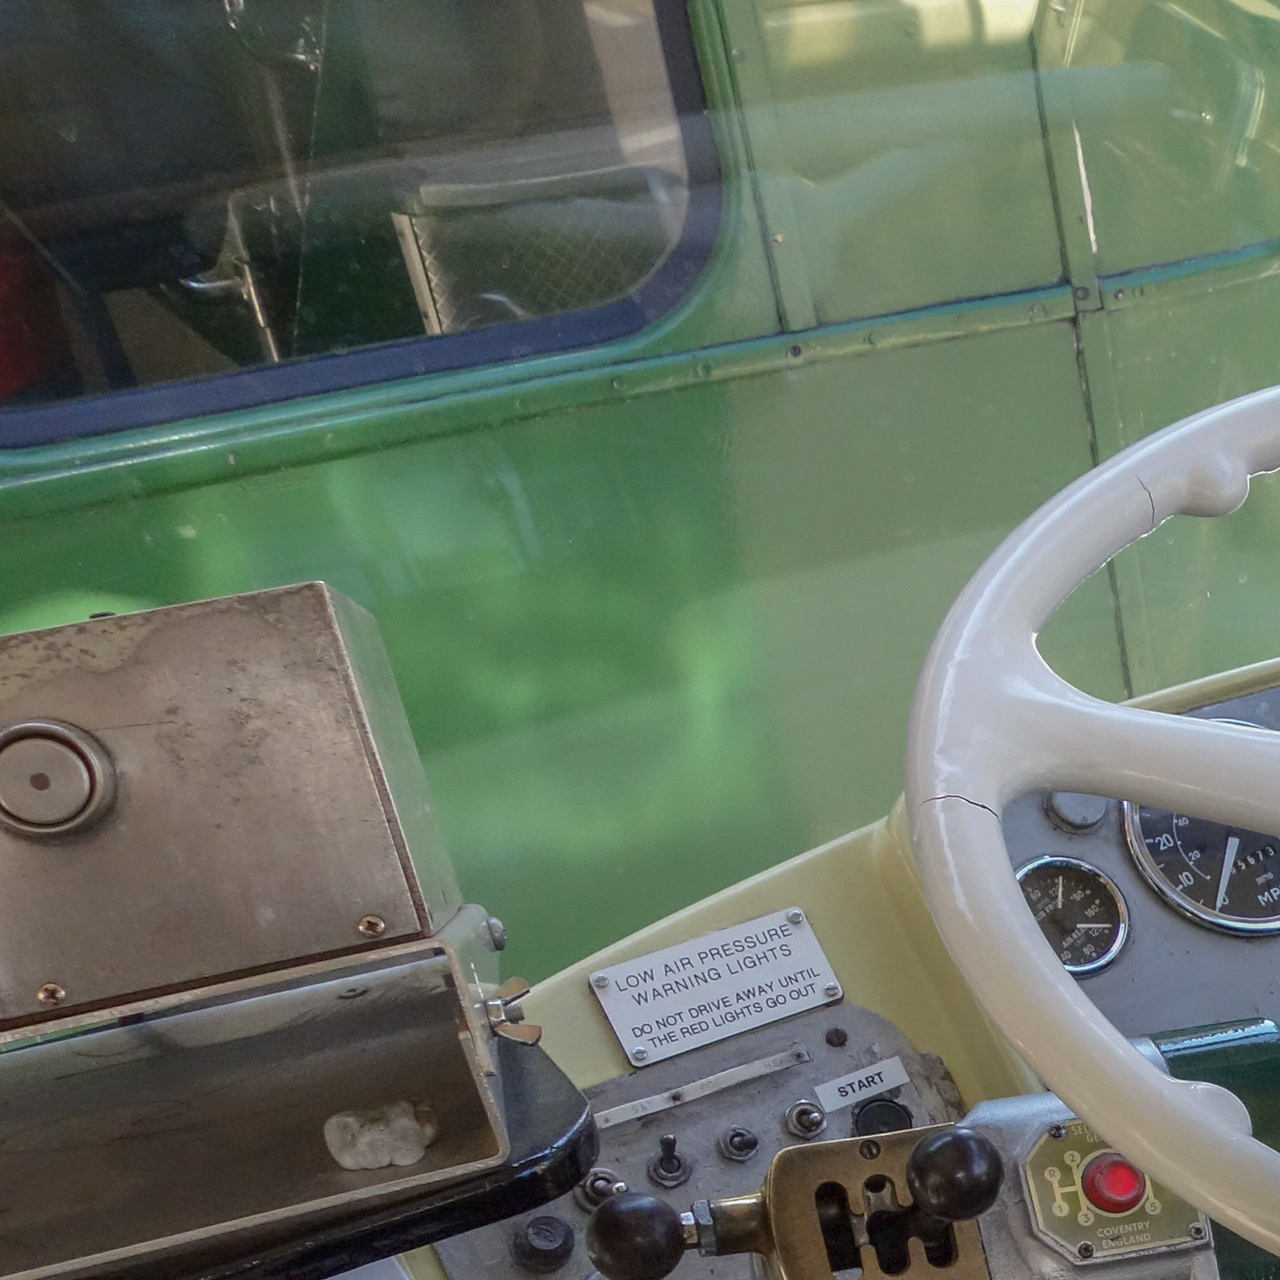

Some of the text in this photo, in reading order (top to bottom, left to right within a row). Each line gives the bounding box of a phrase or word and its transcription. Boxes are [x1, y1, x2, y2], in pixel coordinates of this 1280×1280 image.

[1154, 831, 1175, 851] 20
[1188, 849, 1201, 861] 20
[1177, 869, 1195, 888] 10
[614, 923, 793, 993] LOW AIR PRESSURE
[631, 942, 793, 1007] WARNING LIGHTS
[630, 965, 820, 1038] DO NOT DRIVE AWAY UNTIL
[647, 982, 817, 1049] THE RED LIGHTS GO OUT
[836, 1070, 887, 1100] START
[1096, 1220, 1150, 1237] COVENTRY
[1101, 1233, 1151, 1248] ENGLAND
